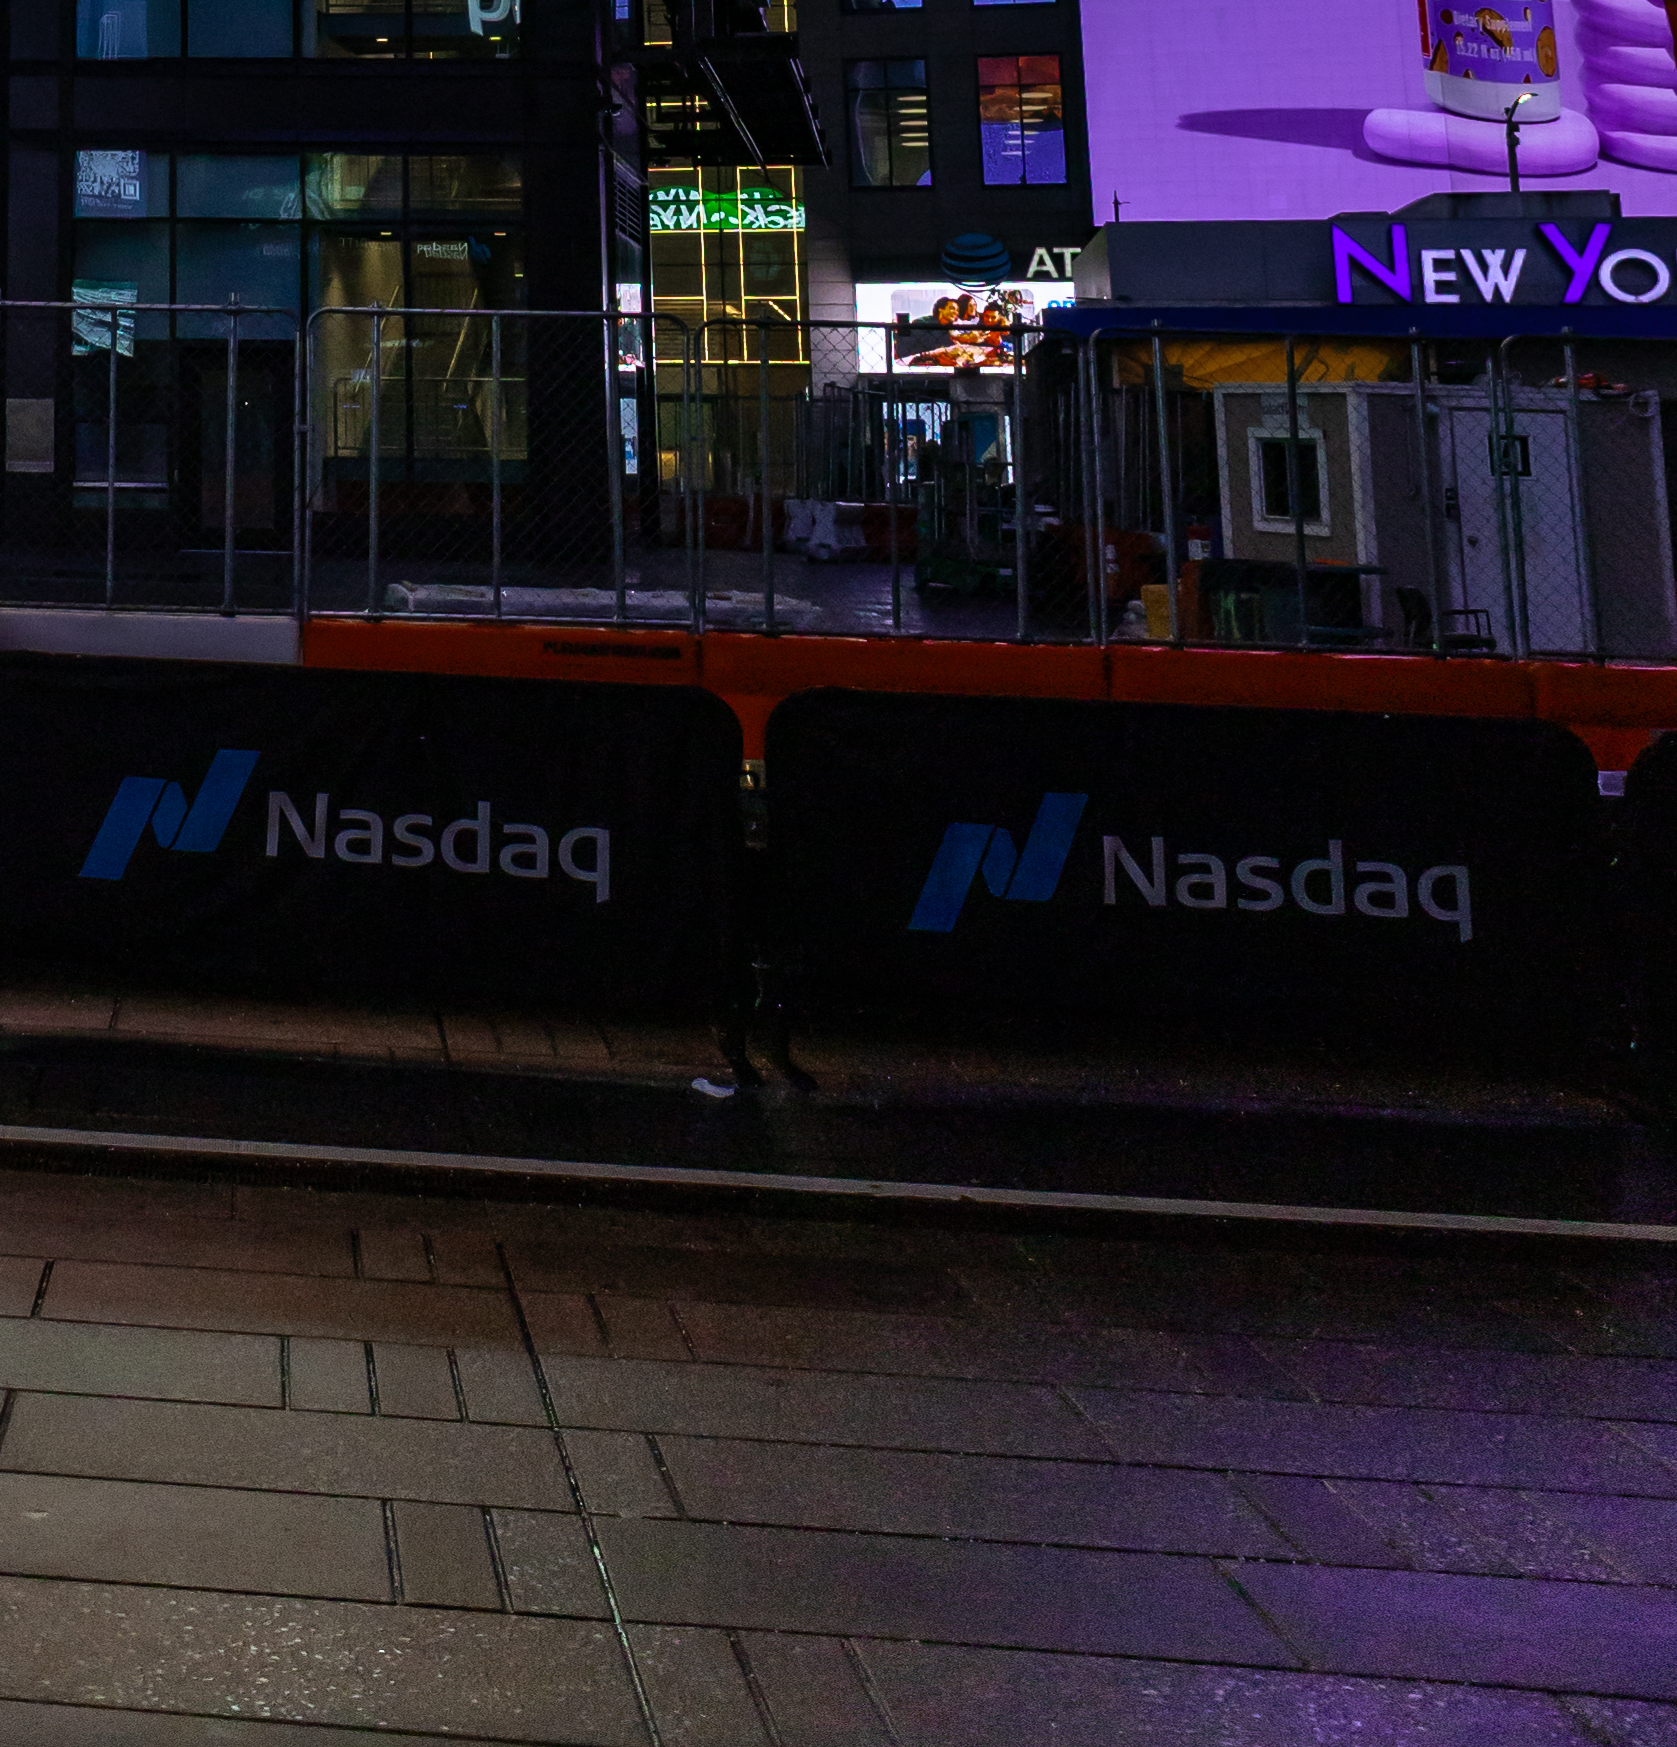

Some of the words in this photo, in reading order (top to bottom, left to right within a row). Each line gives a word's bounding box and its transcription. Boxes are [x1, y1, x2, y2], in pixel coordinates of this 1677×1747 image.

[1330, 222, 1527, 304] NEW
[1535, 222, 1677, 304] YO
[266, 791, 611, 904] Nasdaq
[1102, 834, 1474, 943] Nasdaq
